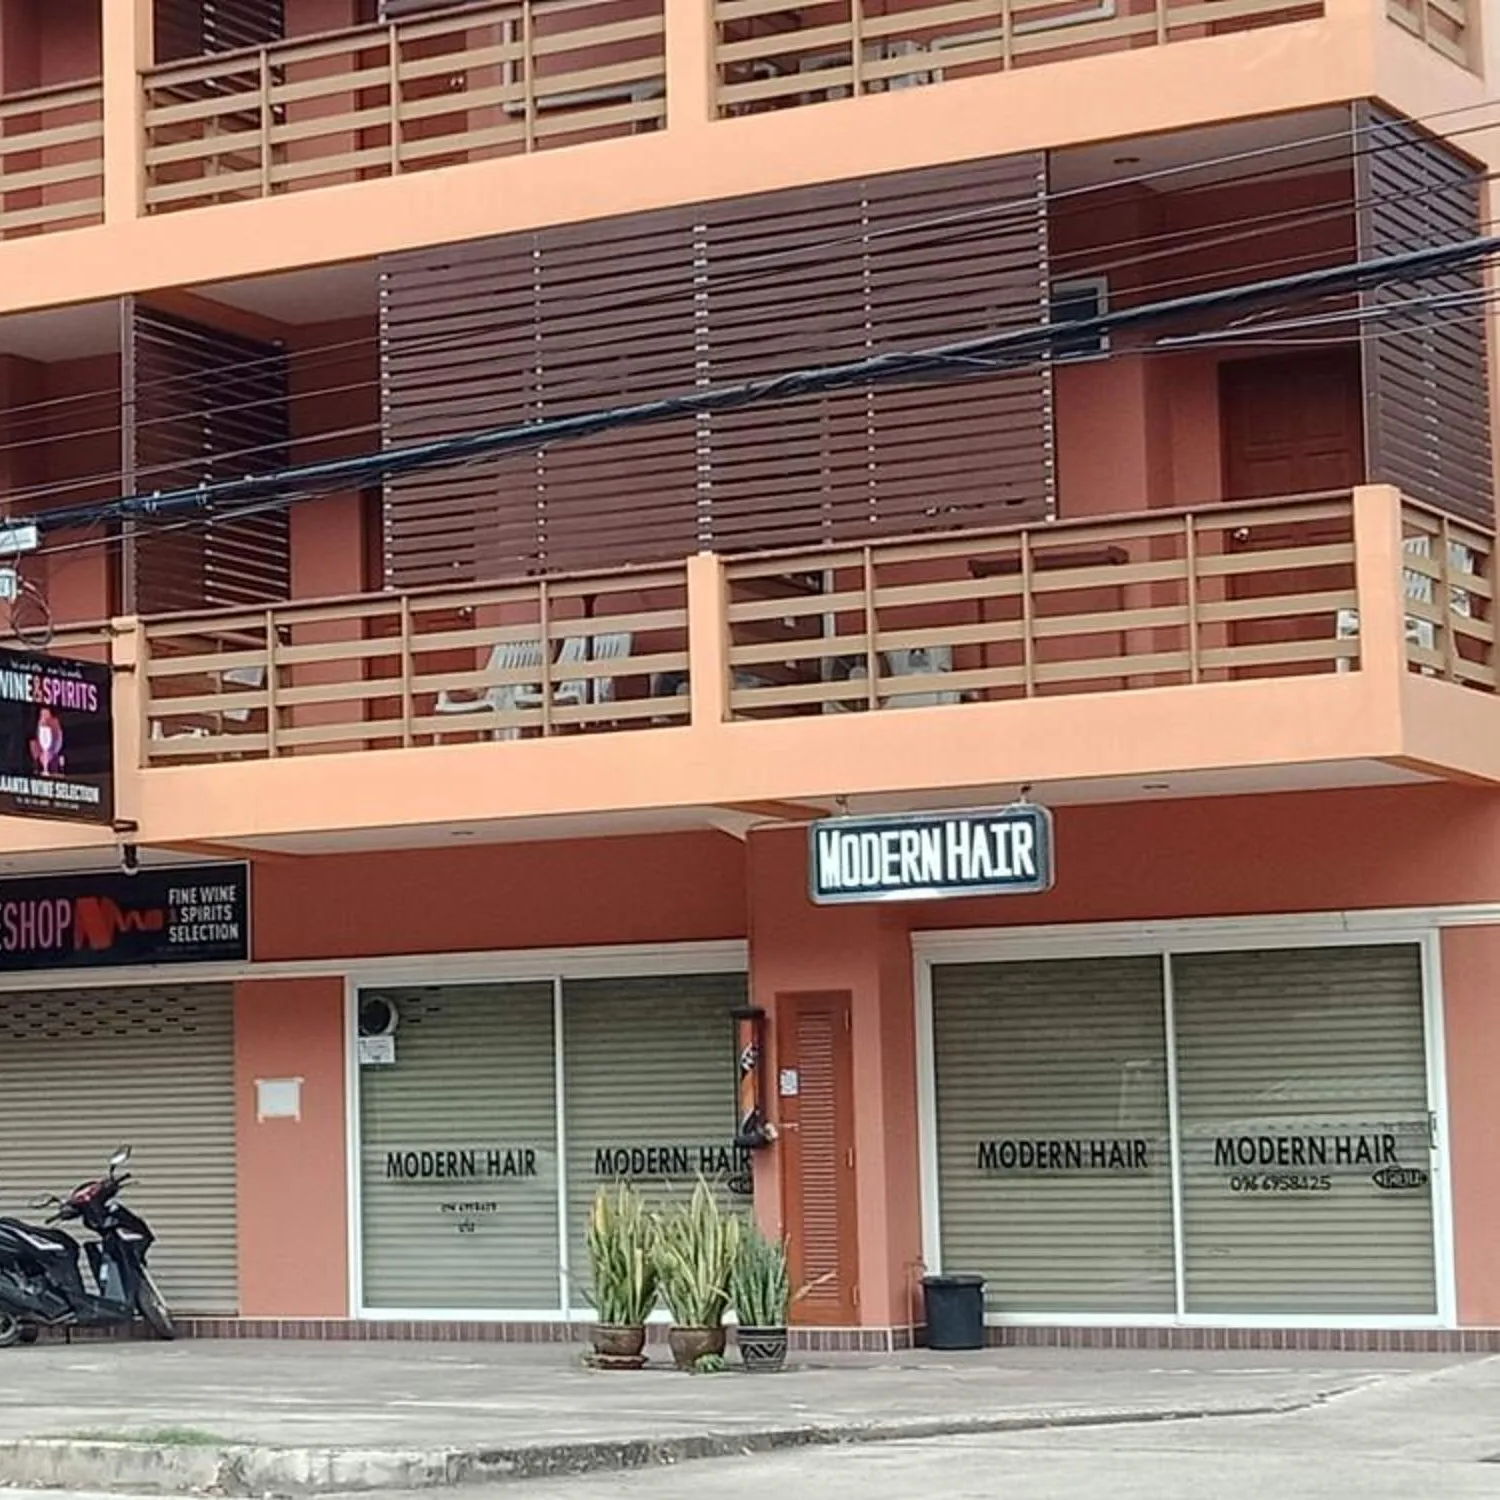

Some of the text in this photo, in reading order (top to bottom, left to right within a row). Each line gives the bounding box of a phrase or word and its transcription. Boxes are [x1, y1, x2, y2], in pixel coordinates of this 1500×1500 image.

[818, 820, 1036, 889] MODERN HAIR
[168, 885, 237, 905] FINE WINE
[180, 904, 233, 923] SPIRITS
[168, 923, 239, 943] SELECTION
[386, 1148, 538, 1177] MODERN HAIR
[595, 1145, 752, 1175] MODERN HAIR
[977, 1138, 1149, 1169] MODERN HAIR
[1214, 1133, 1398, 1166] MODERN HAIR
